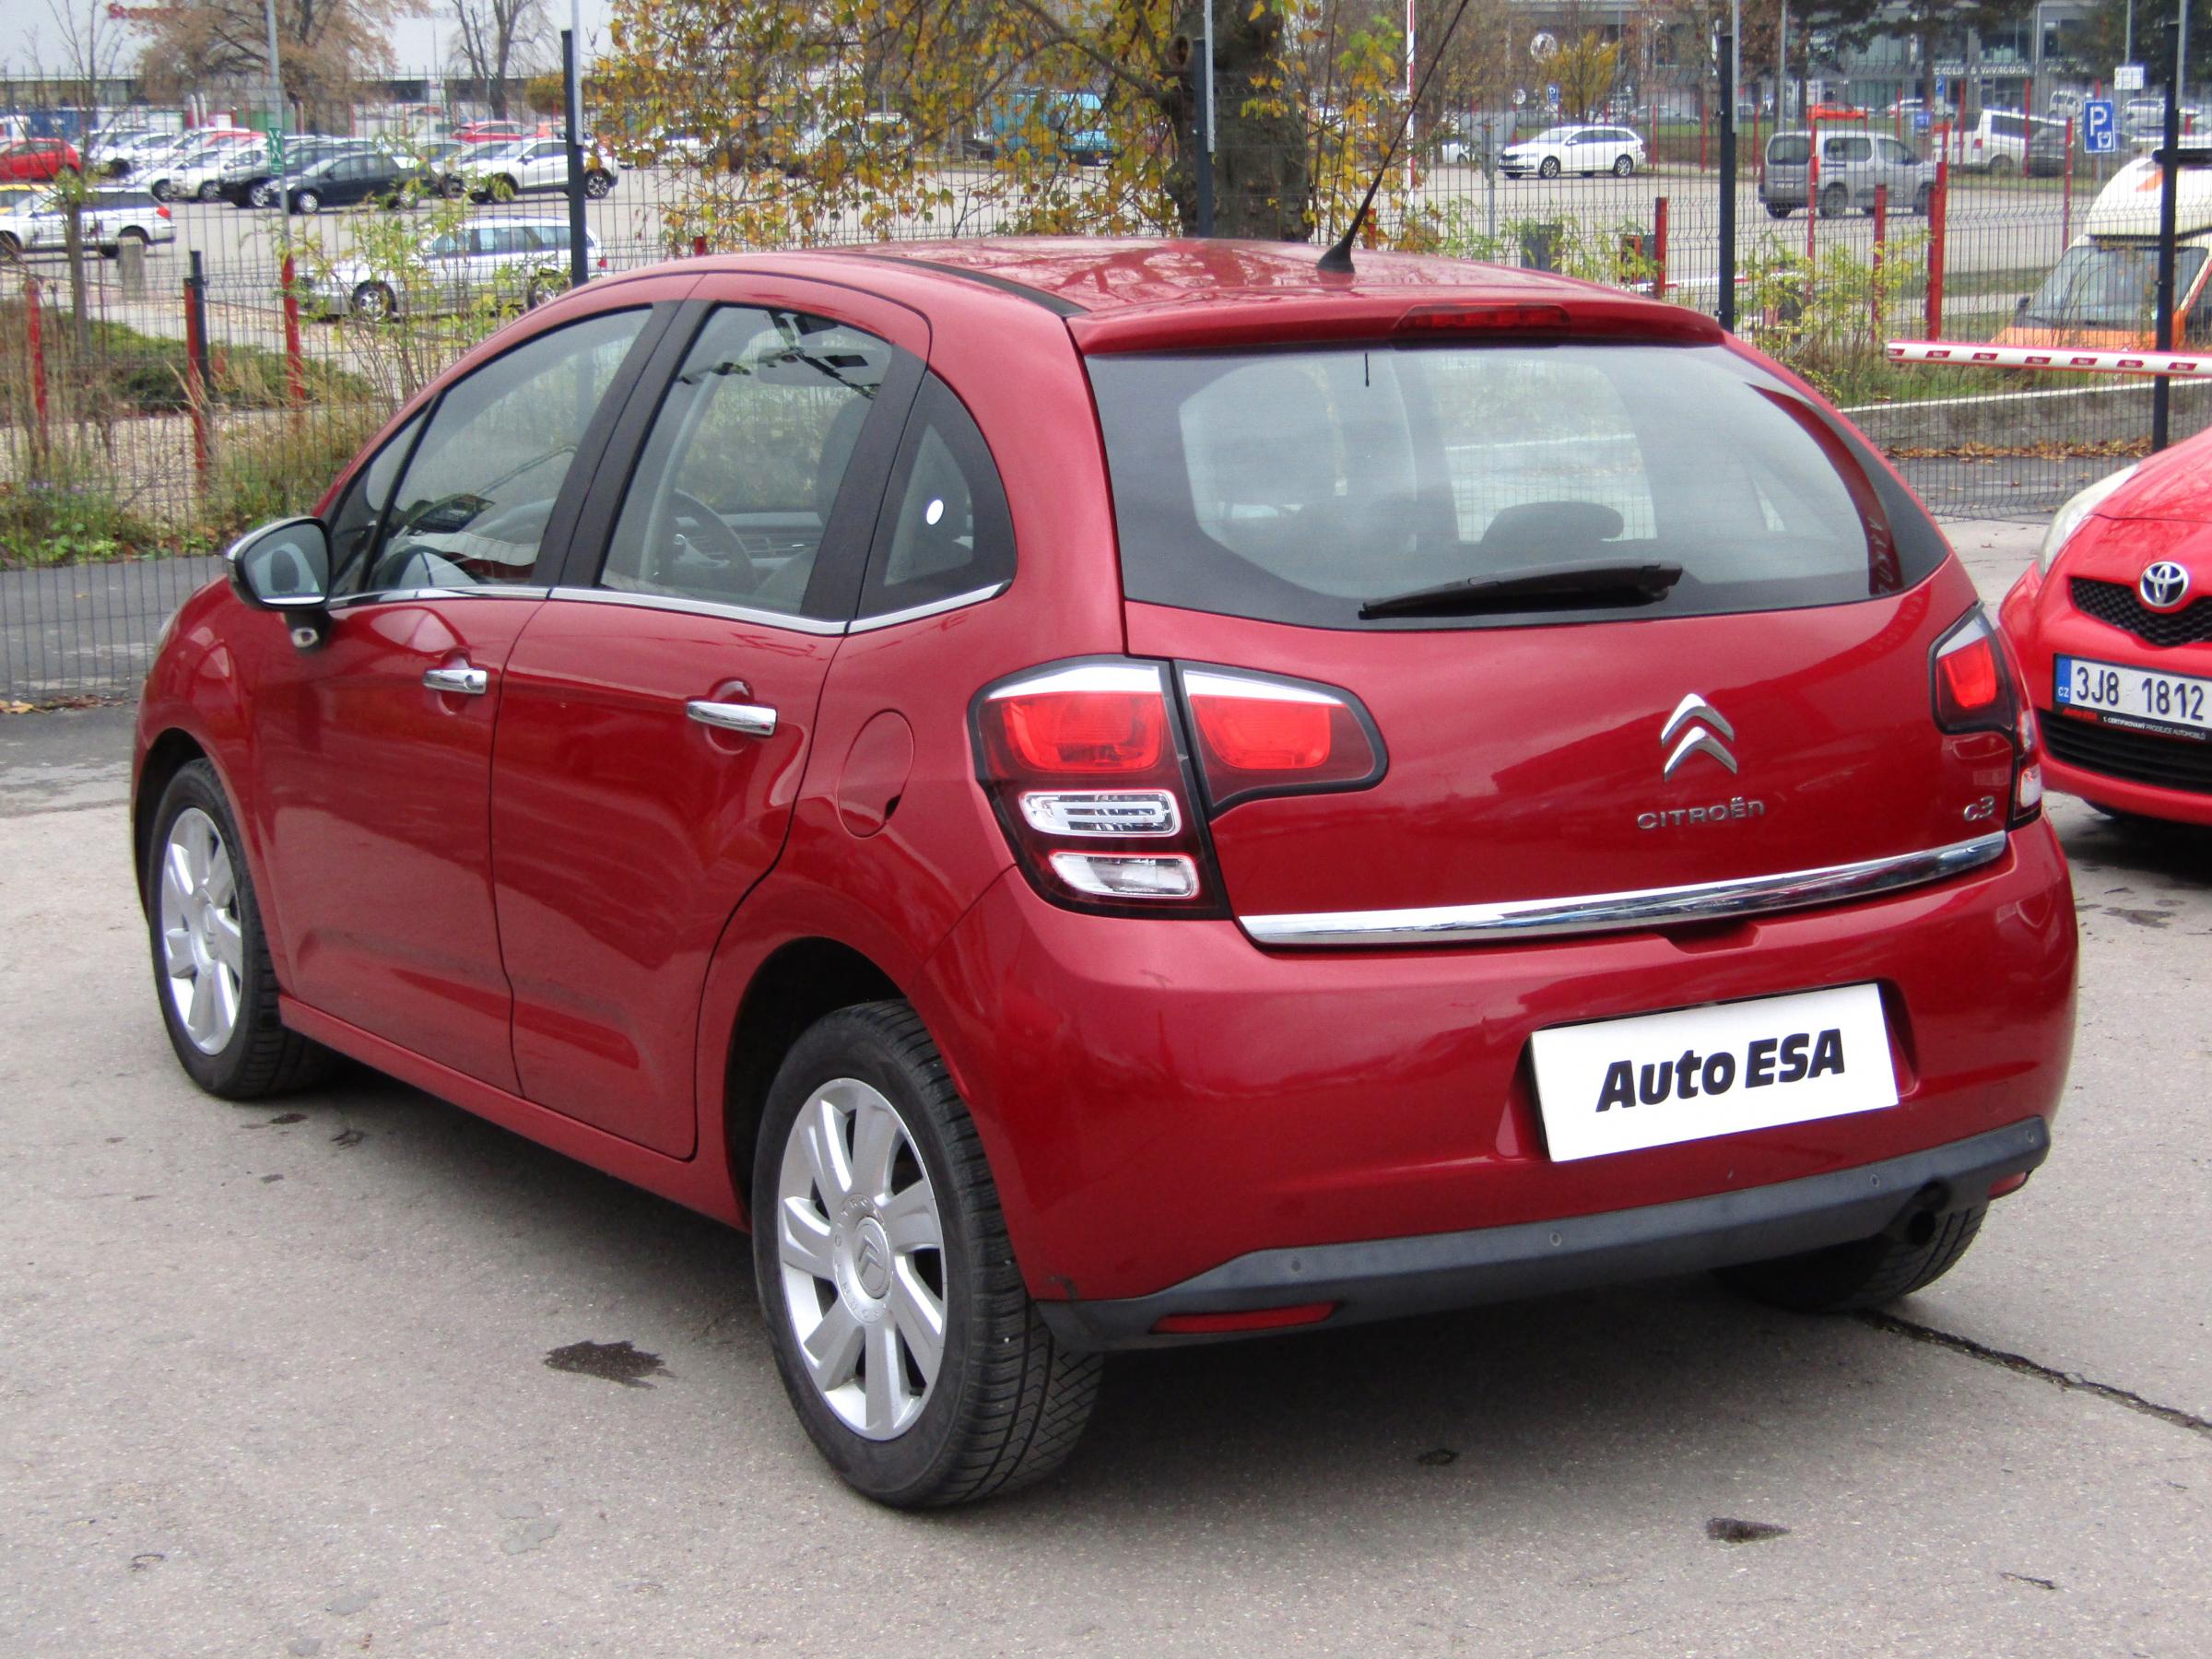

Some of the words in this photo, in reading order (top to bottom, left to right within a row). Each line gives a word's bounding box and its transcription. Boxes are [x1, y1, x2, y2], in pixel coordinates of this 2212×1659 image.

[2089, 106, 2107, 137] P
[2057, 686, 2070, 699] CZ
[2076, 666, 2119, 706] 3J8
[2141, 677, 2205, 722] 1812
[1595, 1049, 1736, 1112] Auto
[1745, 1028, 1845, 1089] ESA
